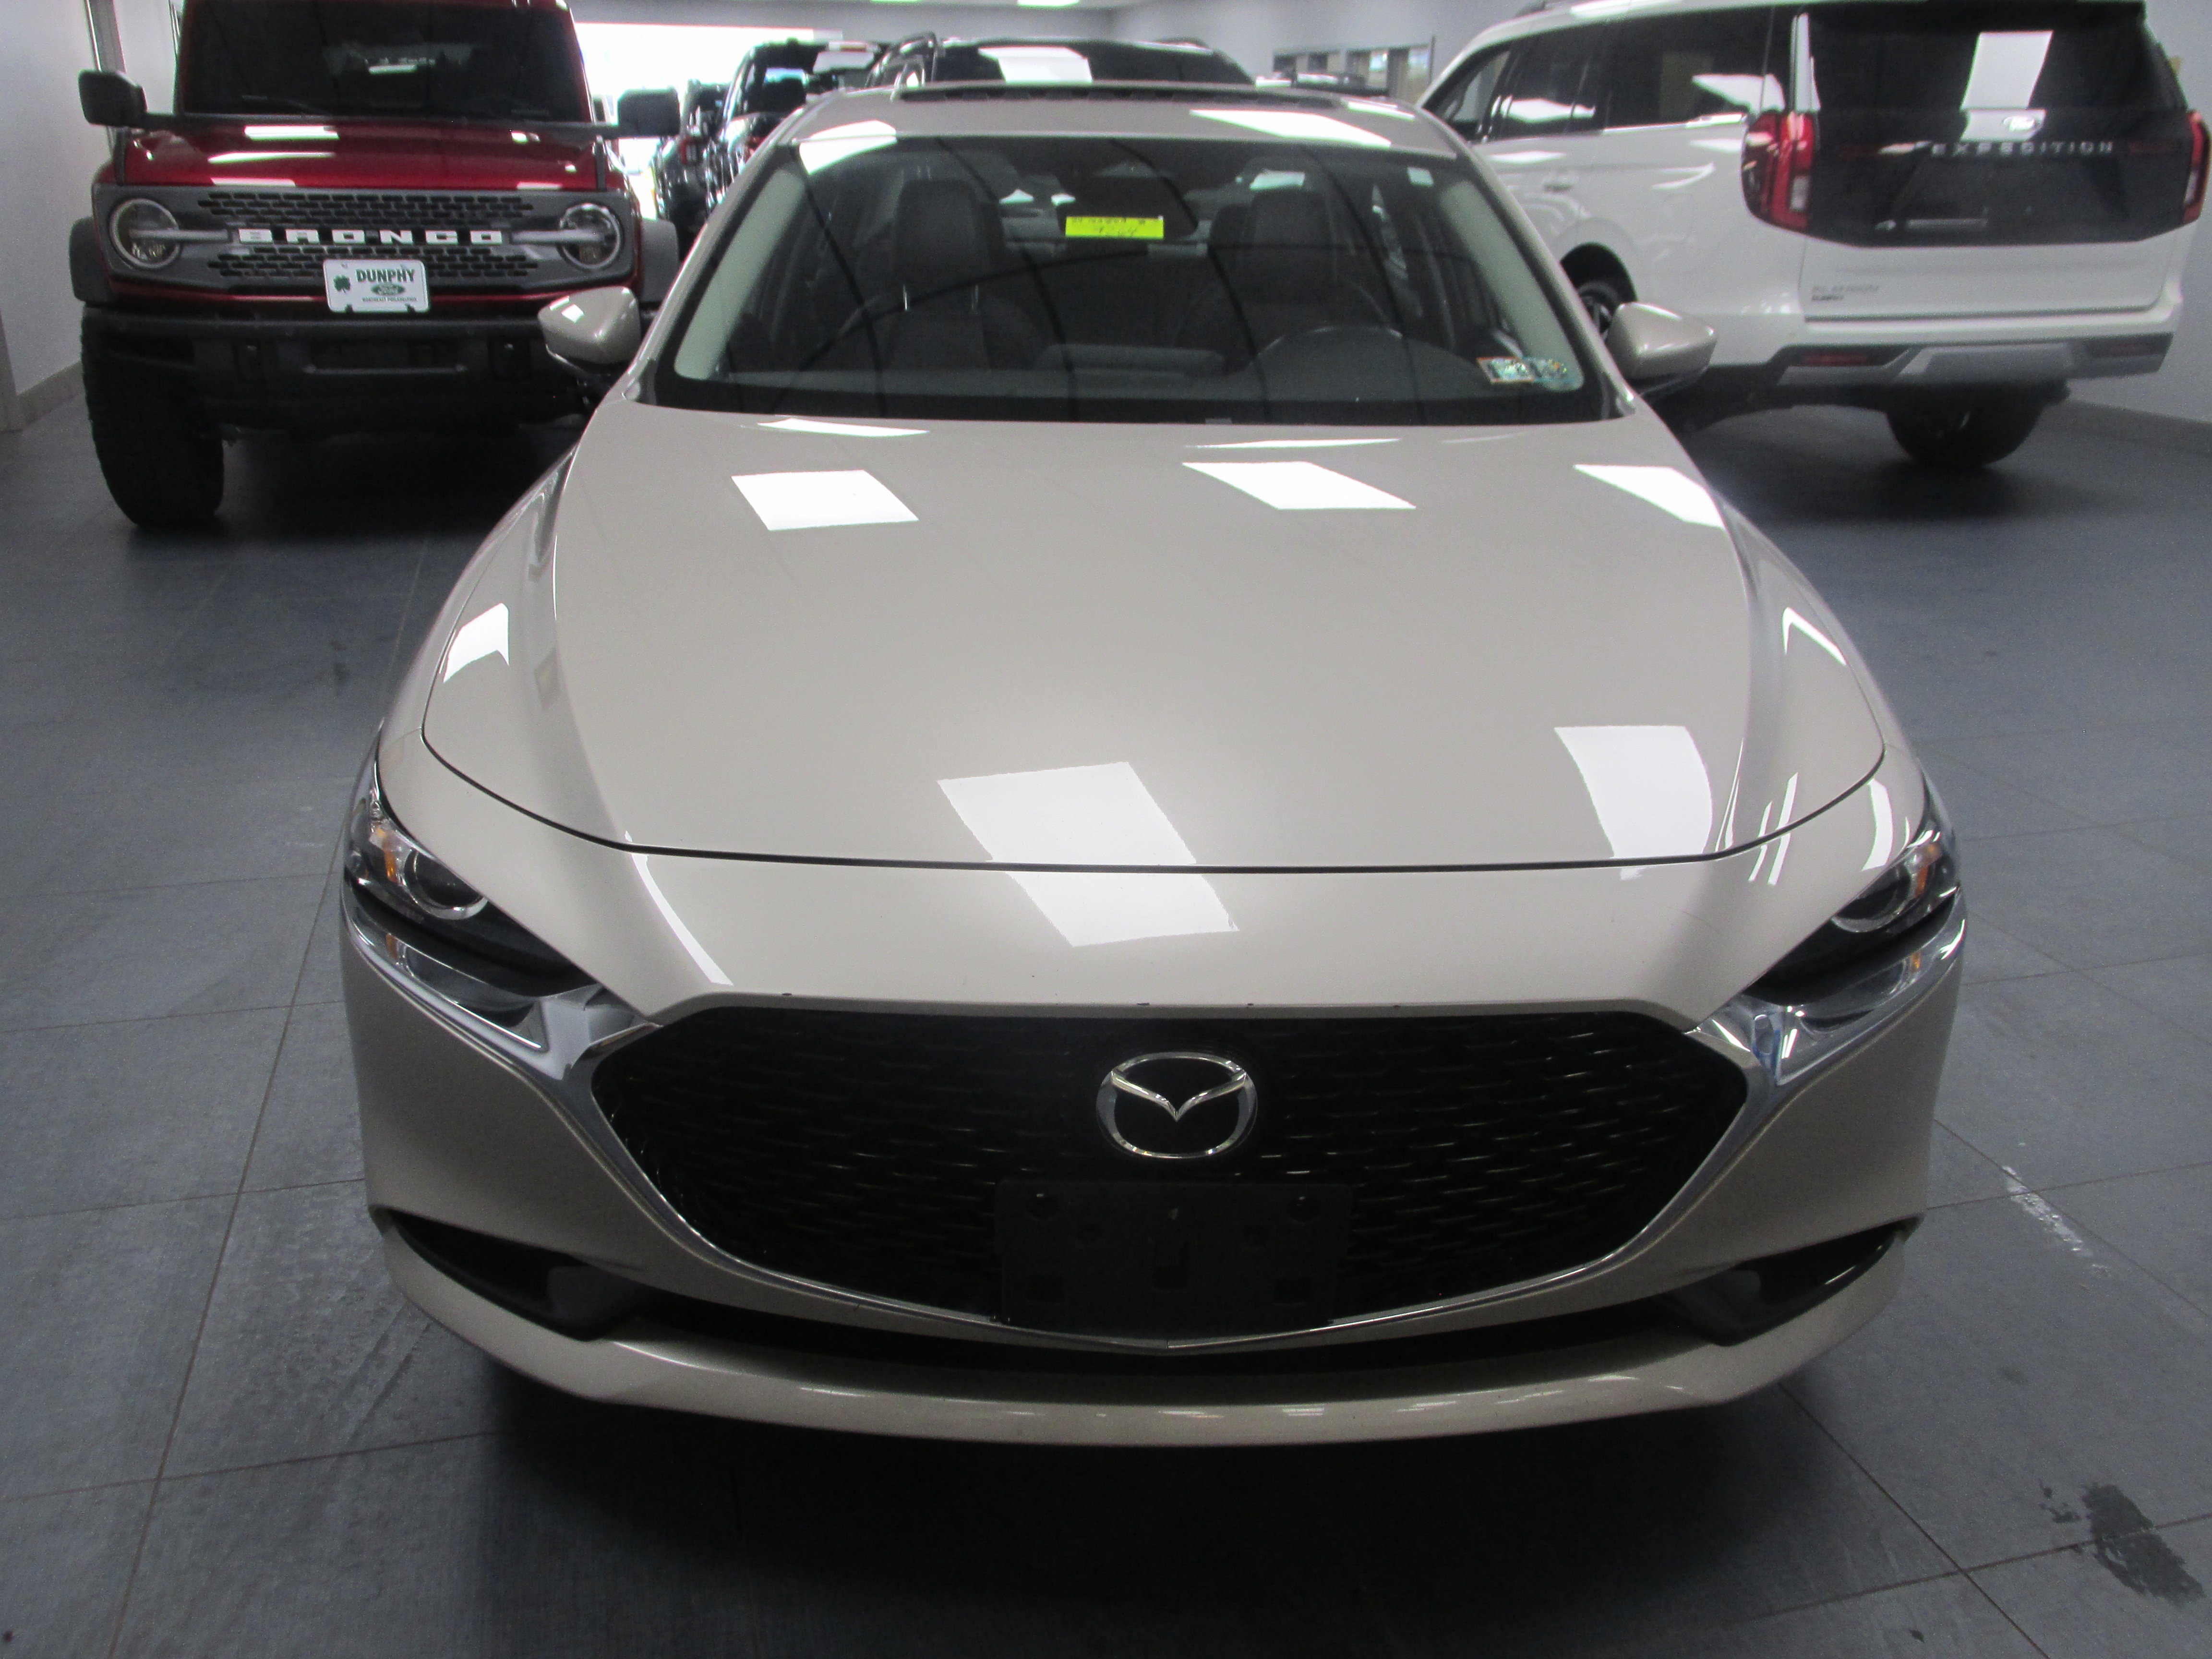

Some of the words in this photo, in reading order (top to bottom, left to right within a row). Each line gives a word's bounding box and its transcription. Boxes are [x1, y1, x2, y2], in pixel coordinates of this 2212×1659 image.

[1931, 141, 2113, 156] EXPEDITION
[239, 229, 502, 245] BRONCO
[356, 269, 415, 282] DUNPHY
